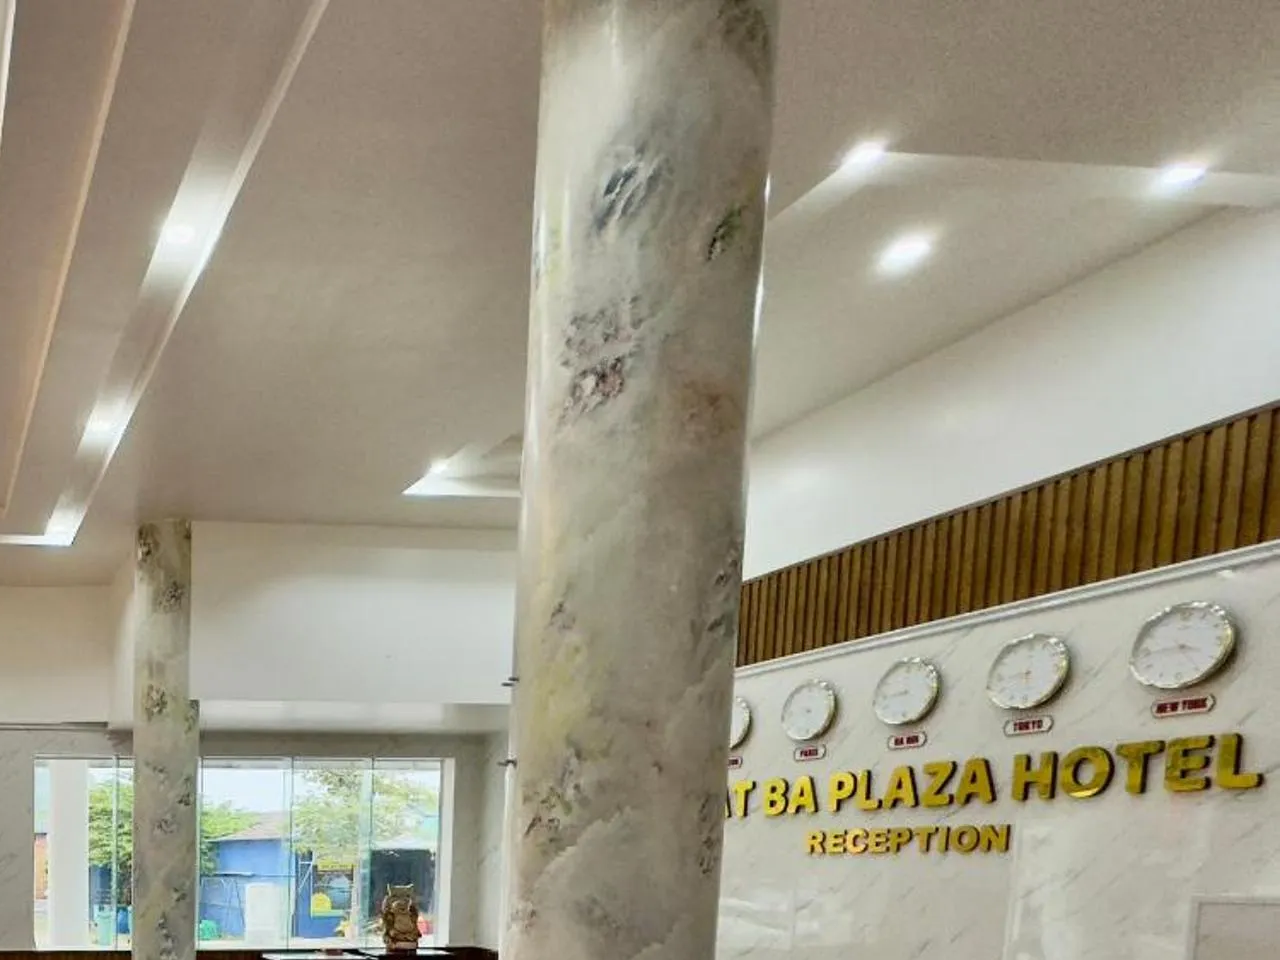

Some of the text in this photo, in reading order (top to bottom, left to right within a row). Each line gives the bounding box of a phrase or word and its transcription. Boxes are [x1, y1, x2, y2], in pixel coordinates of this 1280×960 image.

[763, 775, 819, 817] BA
[827, 756, 997, 815] PLAZA
[1011, 733, 1266, 802] HOTEL
[804, 824, 1010, 855] RECEPTION
